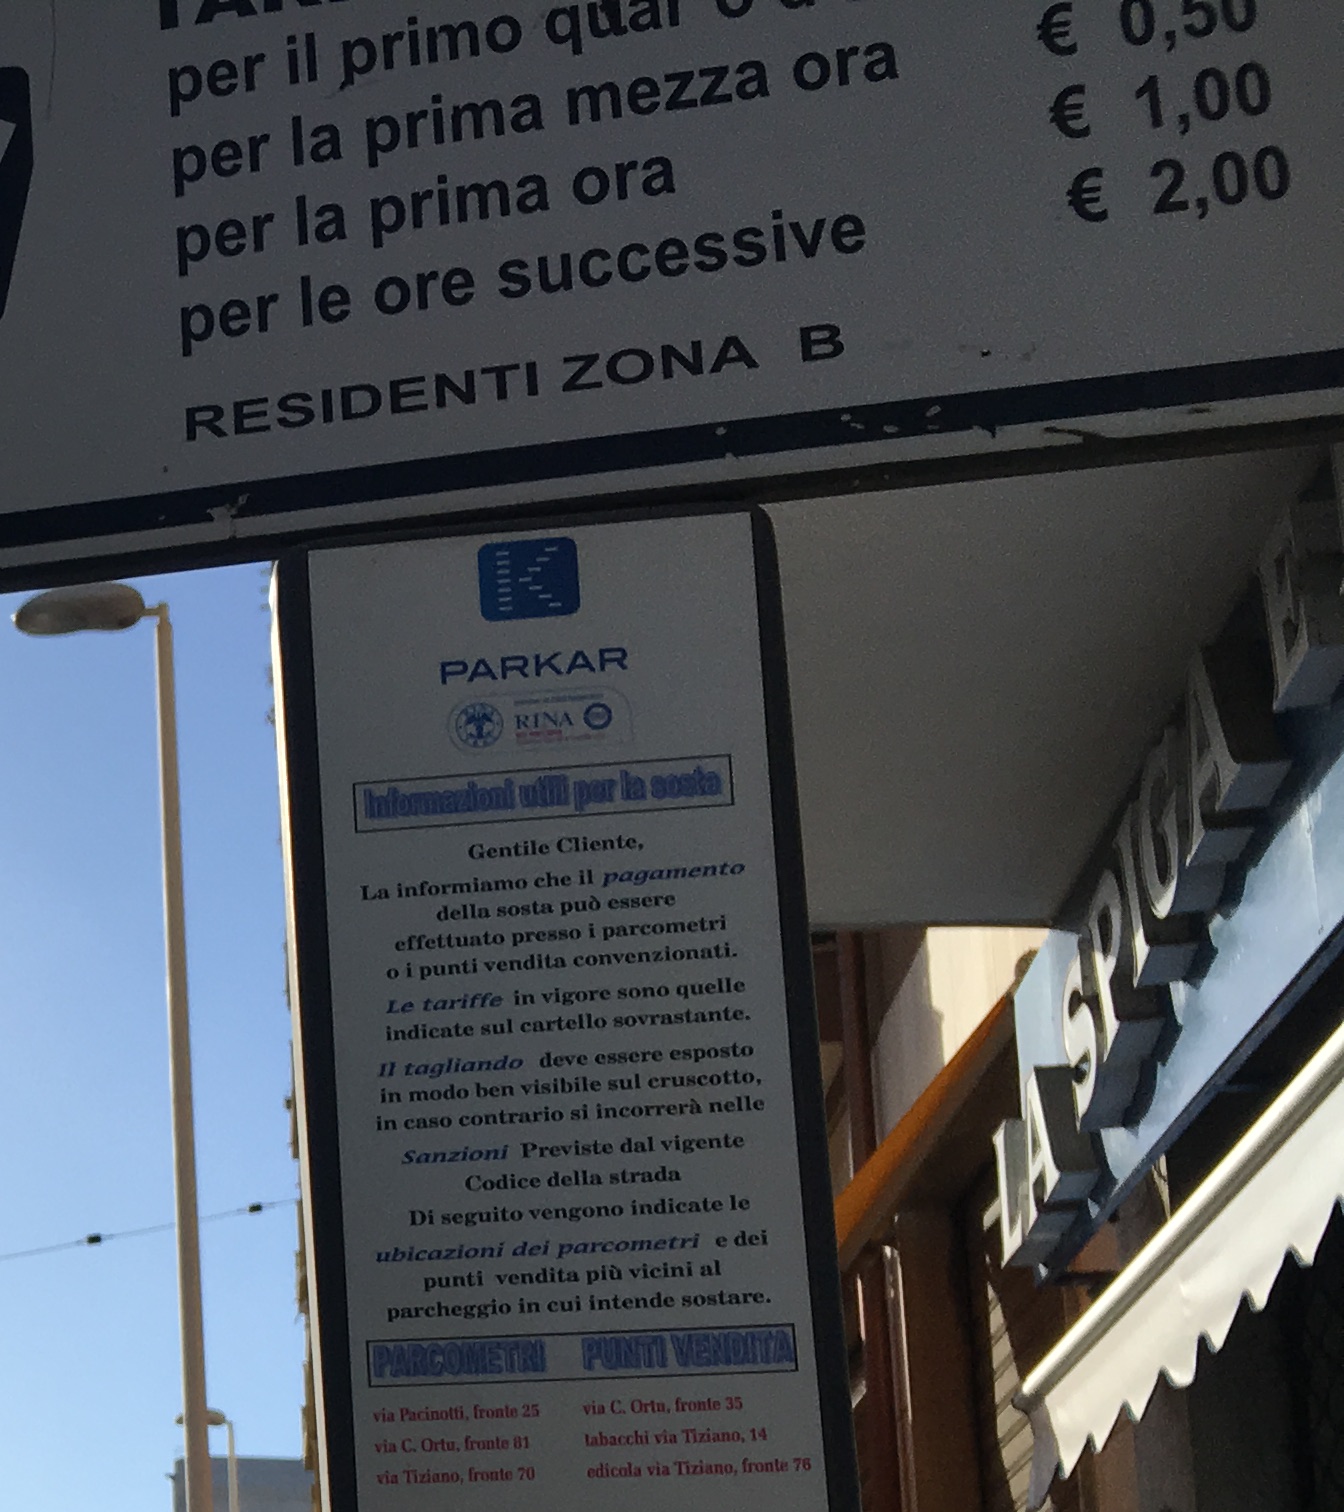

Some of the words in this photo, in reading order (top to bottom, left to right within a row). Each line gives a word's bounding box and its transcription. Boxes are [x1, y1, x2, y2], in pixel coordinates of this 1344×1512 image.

[1037, 2, 1078, 56] €
[168, 53, 266, 117] per
[287, 32, 317, 85] il
[341, 14, 520, 88] primo
[1049, 84, 1091, 139] €
[1135, 61, 1271, 136] 1,00
[173, 133, 270, 198] per
[291, 115, 343, 166] la
[366, 94, 545, 168] prima
[566, 60, 770, 125] mezza
[793, 42, 899, 91] ora
[1066, 167, 1108, 222] €
[1150, 145, 1290, 220] 2,00
[176, 213, 275, 277] per
[296, 194, 347, 246] la
[370, 174, 550, 249] prima
[573, 156, 676, 205] ora
[181, 293, 279, 357] per
[300, 275, 351, 327] le
[374, 259, 474, 315] ore
[498, 209, 867, 301] successive
[185, 361, 538, 441] RESIDENTI
[562, 336, 760, 392] ZONA
[800, 324, 844, 362] B
[440, 647, 627, 685] PARKAR
[514, 711, 574, 730] RINA
[363, 778, 516, 819] Informazioni
[519, 774, 570, 808] utili
[574, 776, 617, 811] per
[620, 770, 647, 801] la
[650, 766, 722, 800] sosta
[468, 840, 549, 859] Gentile
[557, 835, 643, 853] Cliente,
[360, 885, 390, 900] La
[397, 877, 527, 898] informiamo
[534, 872, 571, 888] che
[602, 863, 745, 888] pagamento
[1062, 648, 1242, 1134] SPIGA
[436, 904, 491, 921] della
[497, 901, 554, 917] sosta
[560, 895, 601, 916] può
[607, 895, 675, 909] essere
[395, 931, 505, 951] effettuato
[512, 929, 581, 947] presso
[602, 915, 726, 941] parcometri
[420, 958, 477, 980] punti
[484, 954, 566, 972] vendita
[573, 944, 737, 967] convenzionati.
[386, 1000, 414, 1014] Le
[423, 992, 503, 1011] tariffe
[514, 990, 535, 1005] in
[541, 988, 610, 1005] vigore
[617, 986, 669, 999] sono
[676, 977, 745, 999] quelle
[386, 1023, 474, 1041] indicate
[481, 1019, 513, 1035] sul
[520, 1013, 607, 1033] cartello
[613, 1007, 751, 1027] sovrastante.
[379, 1062, 396, 1077] Il
[405, 1055, 523, 1079] tagliando
[540, 1052, 588, 1068] deve
[594, 1051, 663, 1064] essere
[669, 1043, 754, 1063] esposto
[381, 1088, 401, 1103] in
[409, 1084, 469, 1102] modo
[475, 1082, 514, 1097] ben
[521, 1076, 601, 1095] visibile
[608, 1073, 641, 1091] sul
[648, 1070, 761, 1088] cruscotto,
[377, 1116, 397, 1131] in
[404, 1117, 452, 1130] caso
[459, 1106, 564, 1127] contrario
[596, 1098, 702, 1119] incorrerà
[709, 1095, 764, 1113] nelle
[402, 1145, 508, 1164] Sanzioni
[522, 1140, 613, 1158] Previste
[620, 1136, 654, 1153] dal
[661, 1134, 744, 1153] vigente
[465, 1174, 541, 1191] Codice
[547, 1170, 602, 1187] della
[610, 1166, 681, 1184] strada
[410, 1210, 434, 1226] Di
[441, 1206, 523, 1226] seguito
[529, 1205, 624, 1221] vengono
[631, 1198, 723, 1215] indicate
[730, 1195, 749, 1210] le
[376, 1242, 504, 1263] ubicazioni
[512, 1241, 549, 1256] dei
[556, 1233, 699, 1259] parcometri
[734, 1230, 767, 1246] dei
[424, 1271, 483, 1292] punti
[496, 1267, 580, 1285] vendita
[586, 1265, 622, 1285] più
[629, 1262, 693, 1279] vicini
[700, 1260, 721, 1276] al
[388, 1301, 511, 1322] parcheggio
[518, 1298, 540, 1313] in
[547, 1301, 581, 1312] cui
[589, 1292, 674, 1310] intende
[682, 1290, 771, 1307] sostare.
[373, 1339, 547, 1378] PARCOMETRI
[581, 1335, 668, 1371] PUNTI
[670, 1330, 794, 1367] VENDITA
[373, 1412, 395, 1422] via
[400, 1406, 469, 1422] Pacinotti,
[473, 1404, 517, 1419] fronte
[522, 1404, 539, 1417] 25
[583, 1405, 605, 1415] via
[631, 1399, 670, 1413] Ortu,
[675, 1397, 720, 1412] fronte
[725, 1396, 743, 1410] 35
[374, 1443, 397, 1453] via
[421, 1438, 460, 1452] Ortu,
[464, 1435, 509, 1450] fronte
[585, 1430, 649, 1446] tabacchi
[654, 1434, 677, 1444] via
[681, 1428, 745, 1443] Tiziano,
[750, 1428, 767, 1441] 14
[377, 1470, 398, 1484] via
[402, 1469, 463, 1484] Tiziano,
[469, 1467, 512, 1482] fronte
[518, 1467, 535, 1480] 70
[587, 1462, 641, 1478] edicola
[647, 1462, 670, 1476] via
[673, 1460, 738, 1475] Tiziano,
[742, 1458, 788, 1473] fronte
